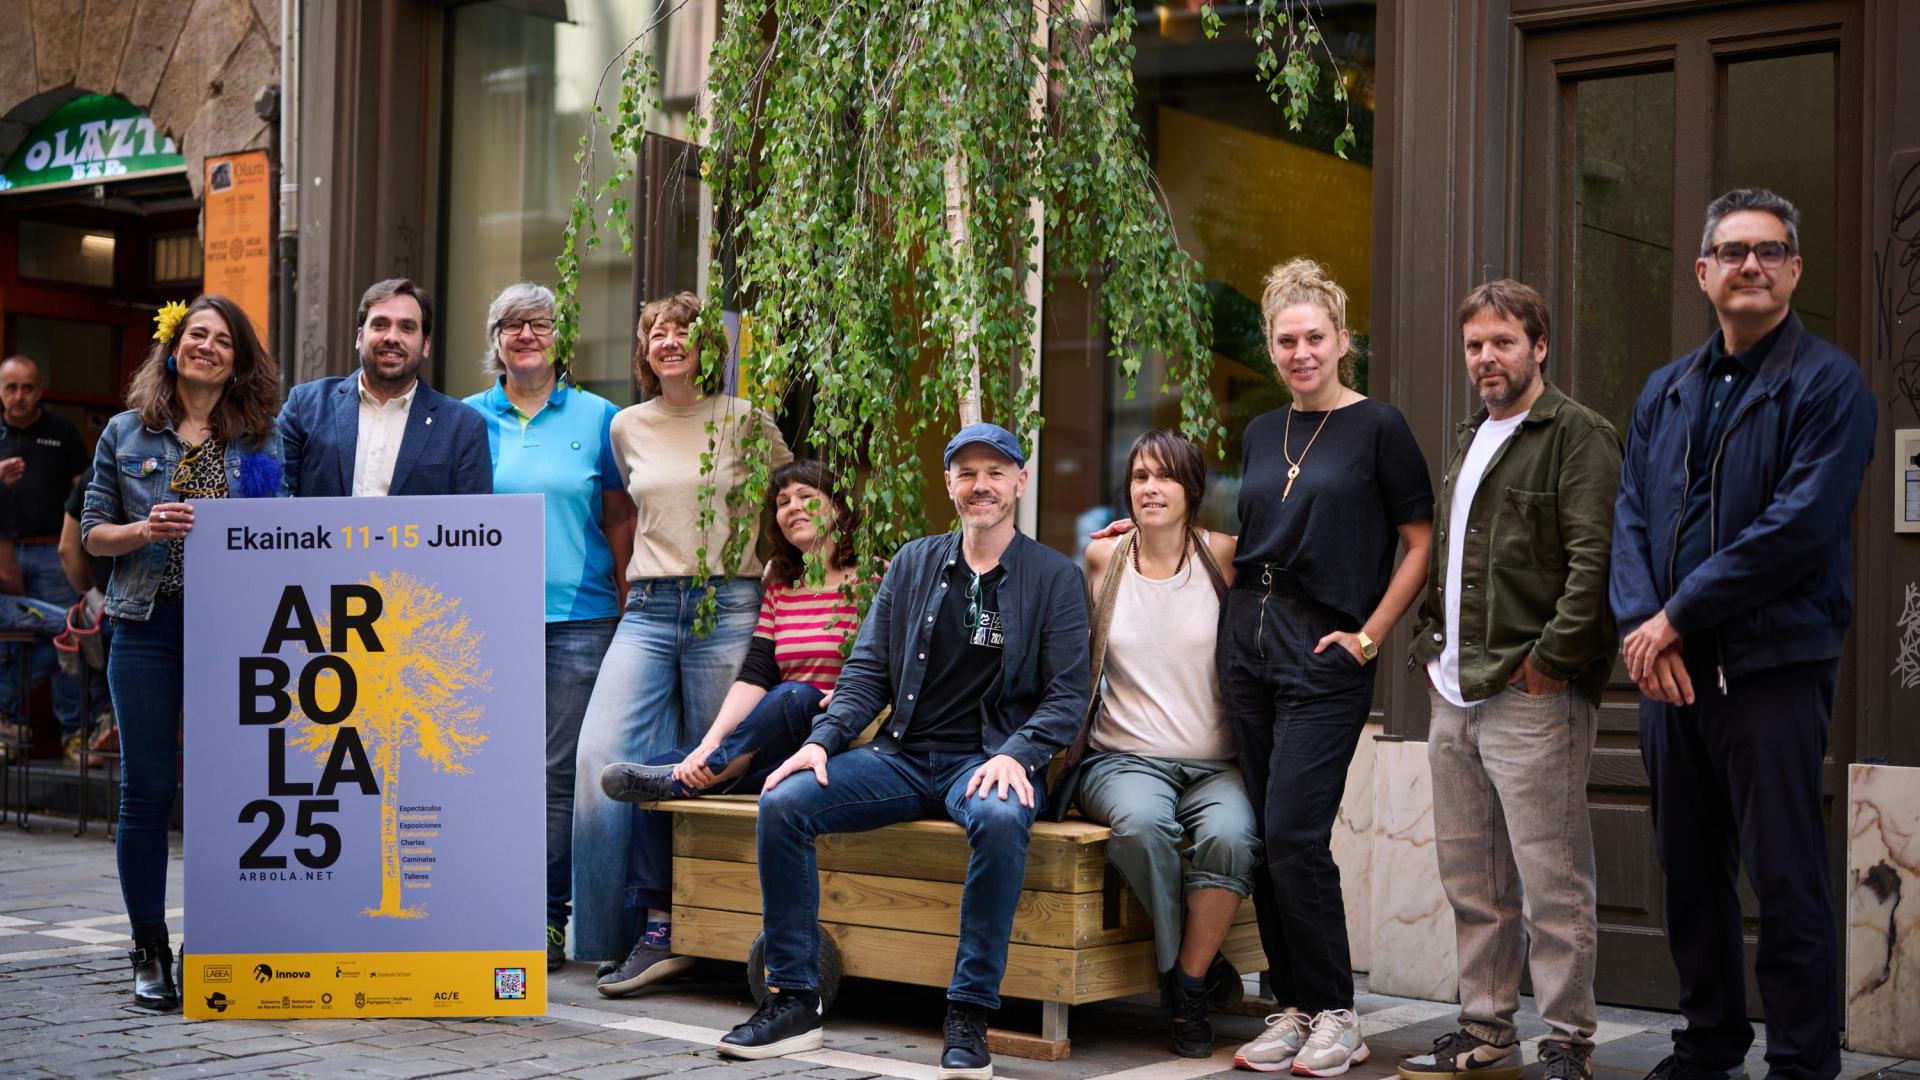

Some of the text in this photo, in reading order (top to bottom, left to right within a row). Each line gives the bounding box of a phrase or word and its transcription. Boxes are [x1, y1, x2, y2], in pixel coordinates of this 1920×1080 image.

[227, 523, 502, 550] Ekainak 11-15 Junio
[261, 584, 385, 654] AR
[238, 655, 358, 725] BO
[268, 727, 380, 796] LA
[399, 804, 442, 813] Espectáculos
[399, 821, 442, 830] Exposiciones
[238, 799, 342, 869] 25
[401, 839, 425, 847] Charlas
[402, 856, 436, 864] Caminatas
[239, 871, 333, 881] ARBOLA.NET
[206, 969, 229, 978] LABEA
[275, 970, 311, 979] innova
[434, 992, 460, 1000] AC/E
